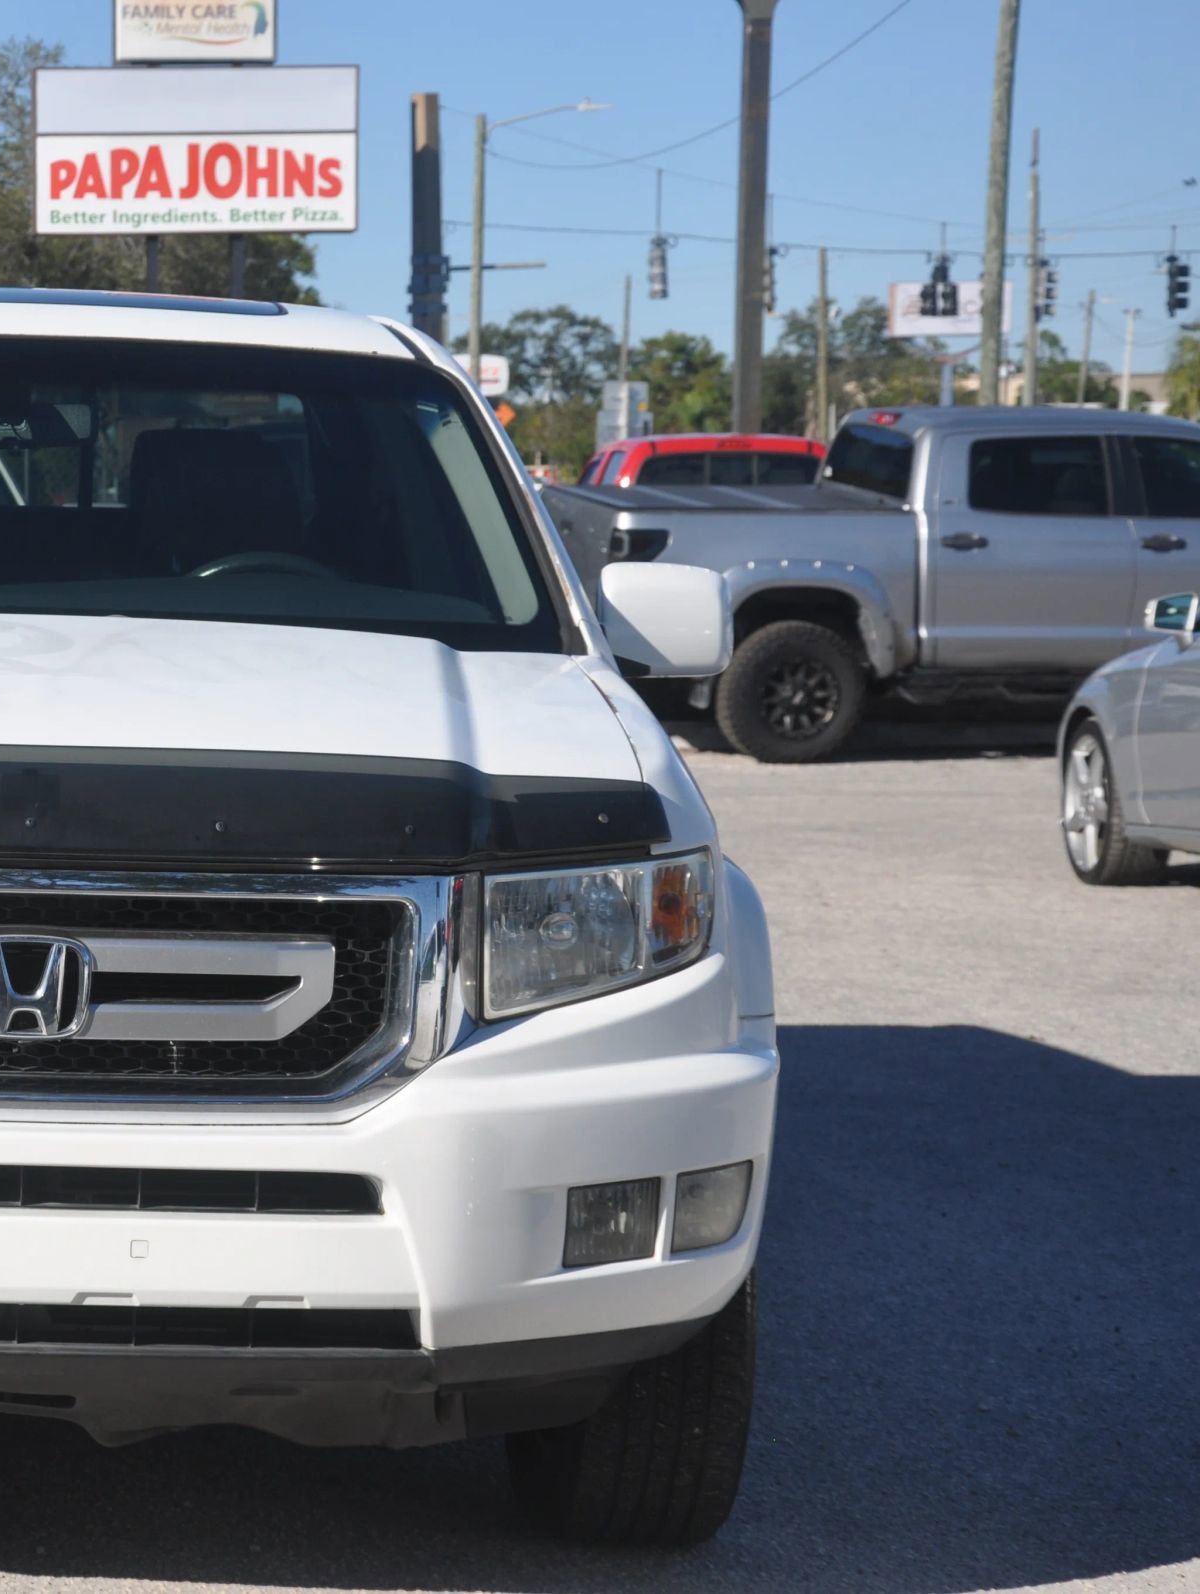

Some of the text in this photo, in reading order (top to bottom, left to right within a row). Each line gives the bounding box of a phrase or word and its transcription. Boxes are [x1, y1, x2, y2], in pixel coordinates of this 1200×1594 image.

[121, 4, 237, 19] FAMILY CARE
[49, 142, 343, 200] PAPA JOHNS
[50, 206, 344, 228] Better Ingredients. Better Pizza.
